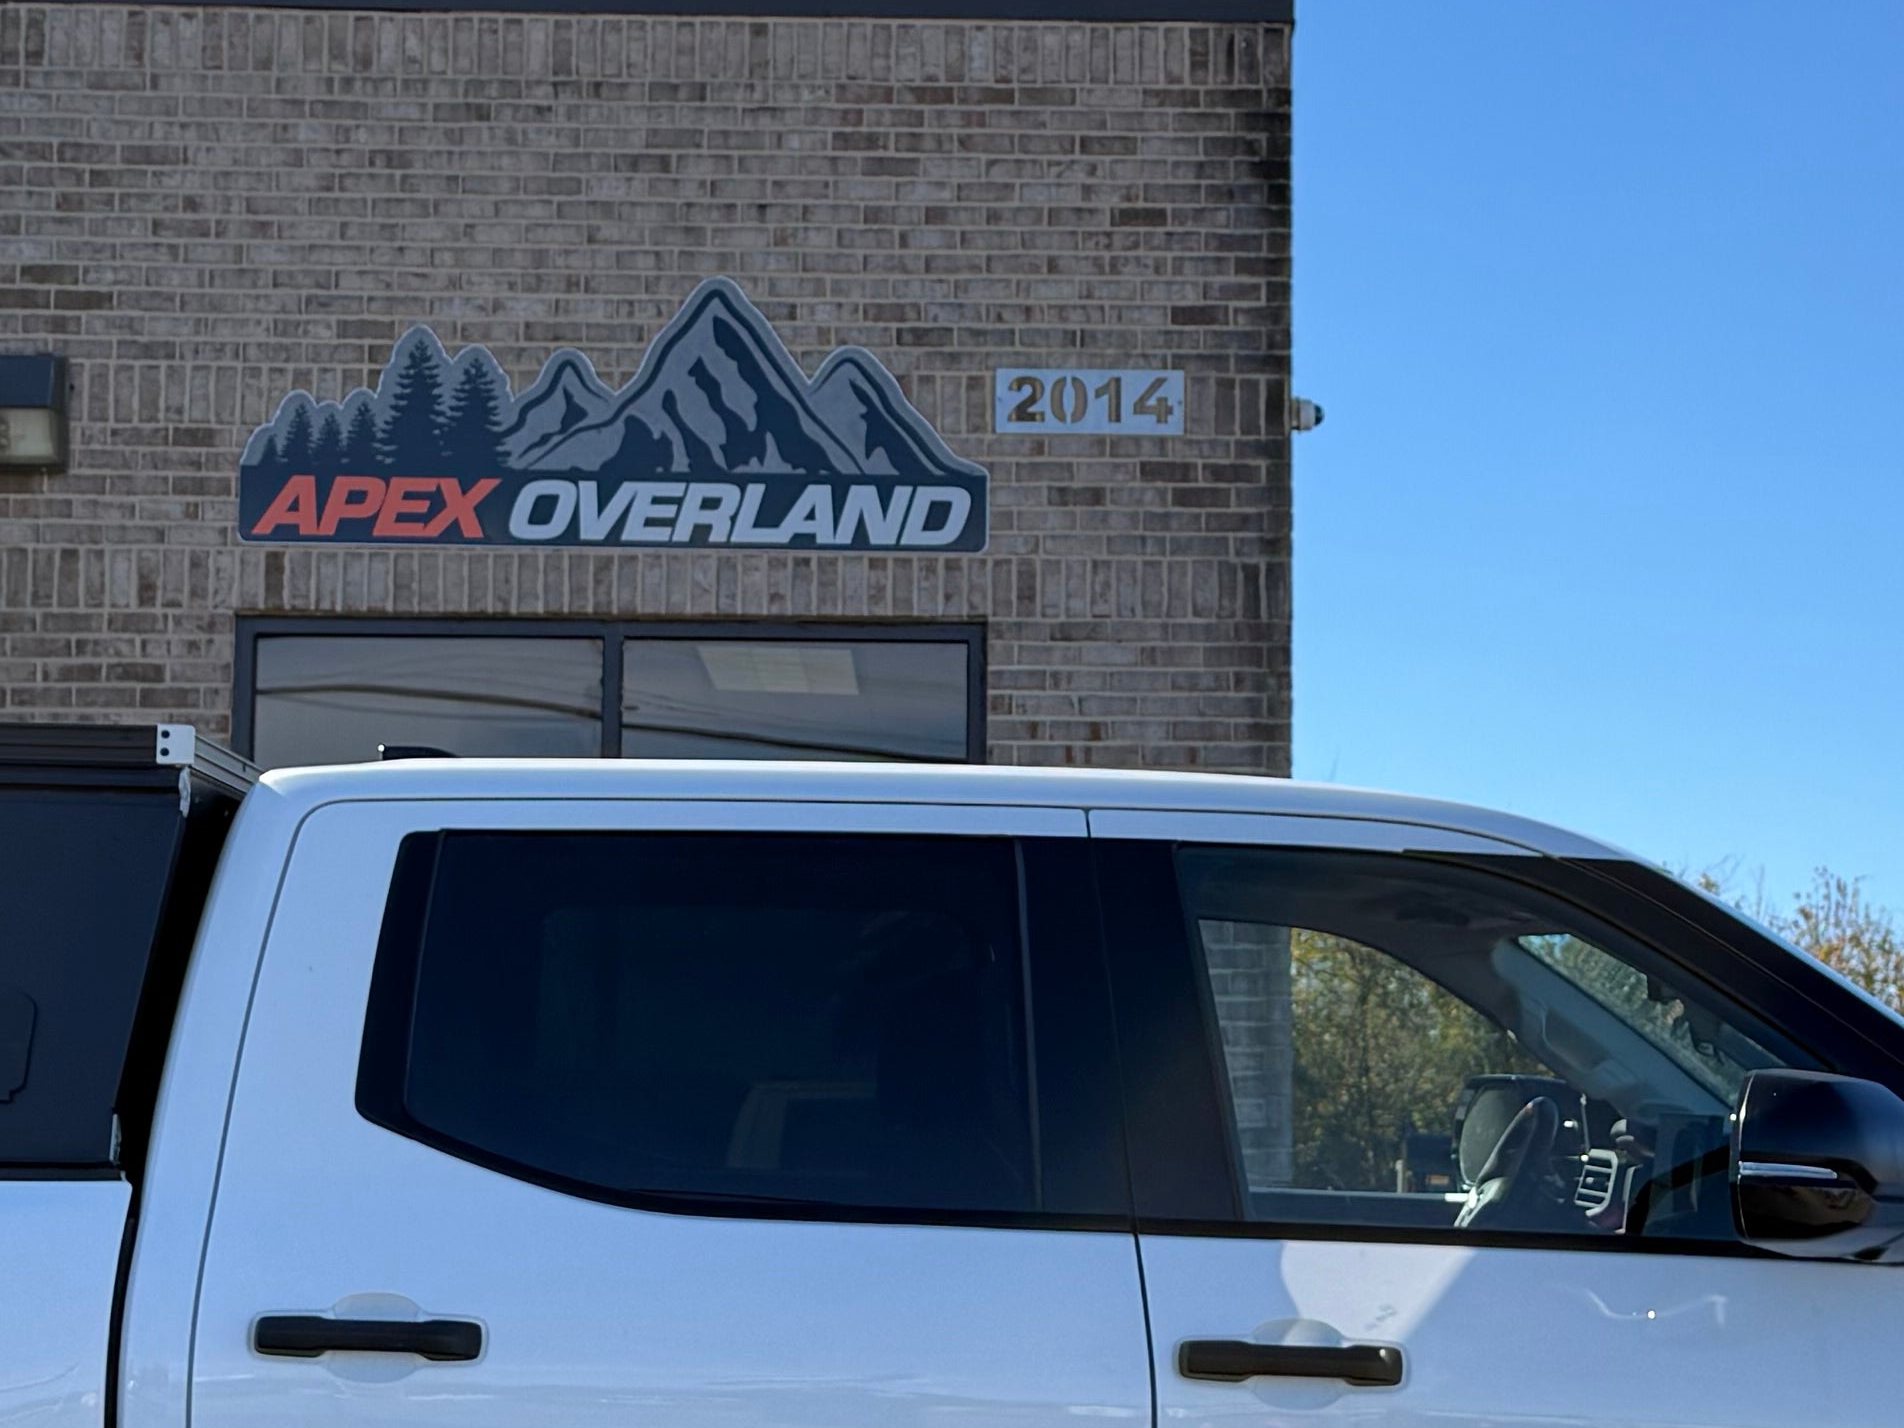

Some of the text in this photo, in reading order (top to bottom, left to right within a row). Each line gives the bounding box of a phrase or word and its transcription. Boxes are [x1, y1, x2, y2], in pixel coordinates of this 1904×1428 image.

[1007, 376, 1174, 424] 2014
[251, 474, 972, 546] APEX OVERLAND
